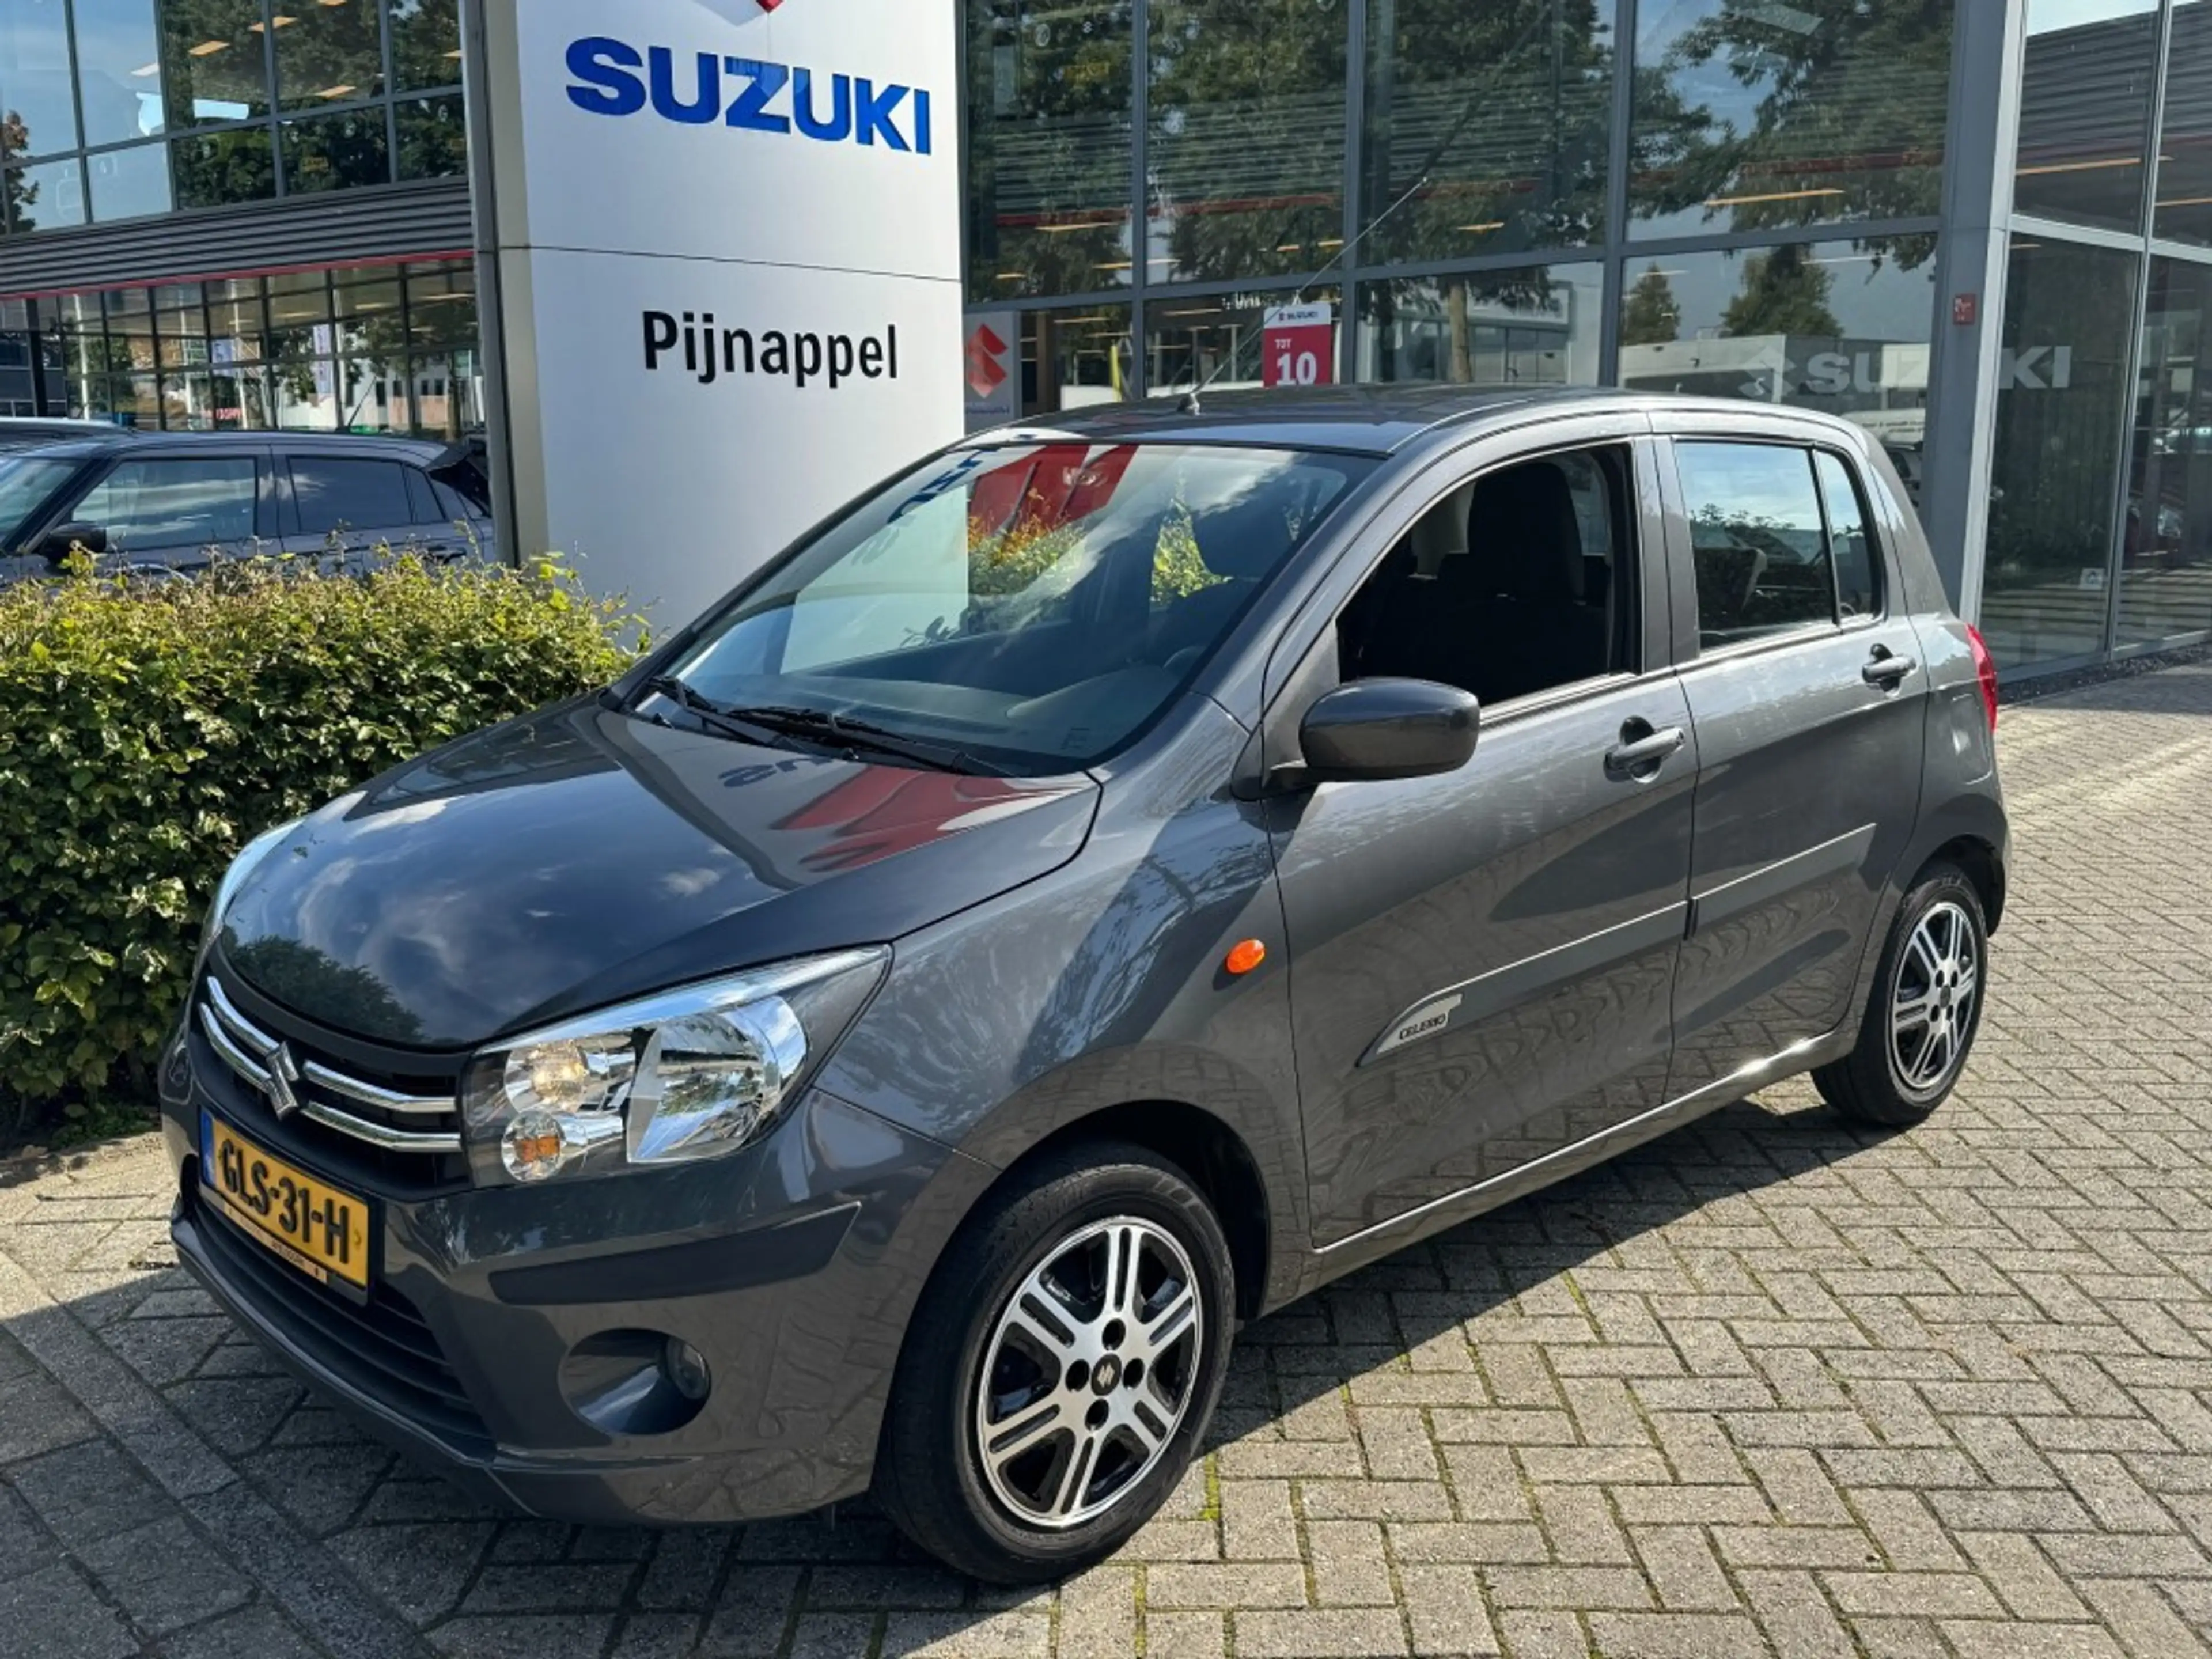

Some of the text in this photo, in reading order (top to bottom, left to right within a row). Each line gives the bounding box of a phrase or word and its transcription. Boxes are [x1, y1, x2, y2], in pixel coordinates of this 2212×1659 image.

[565, 36, 933, 156] SUZUKI
[642, 310, 898, 389] Pijnappel
[1277, 351, 1317, 386] 10
[222, 1138, 349, 1264] GLS-31-H
